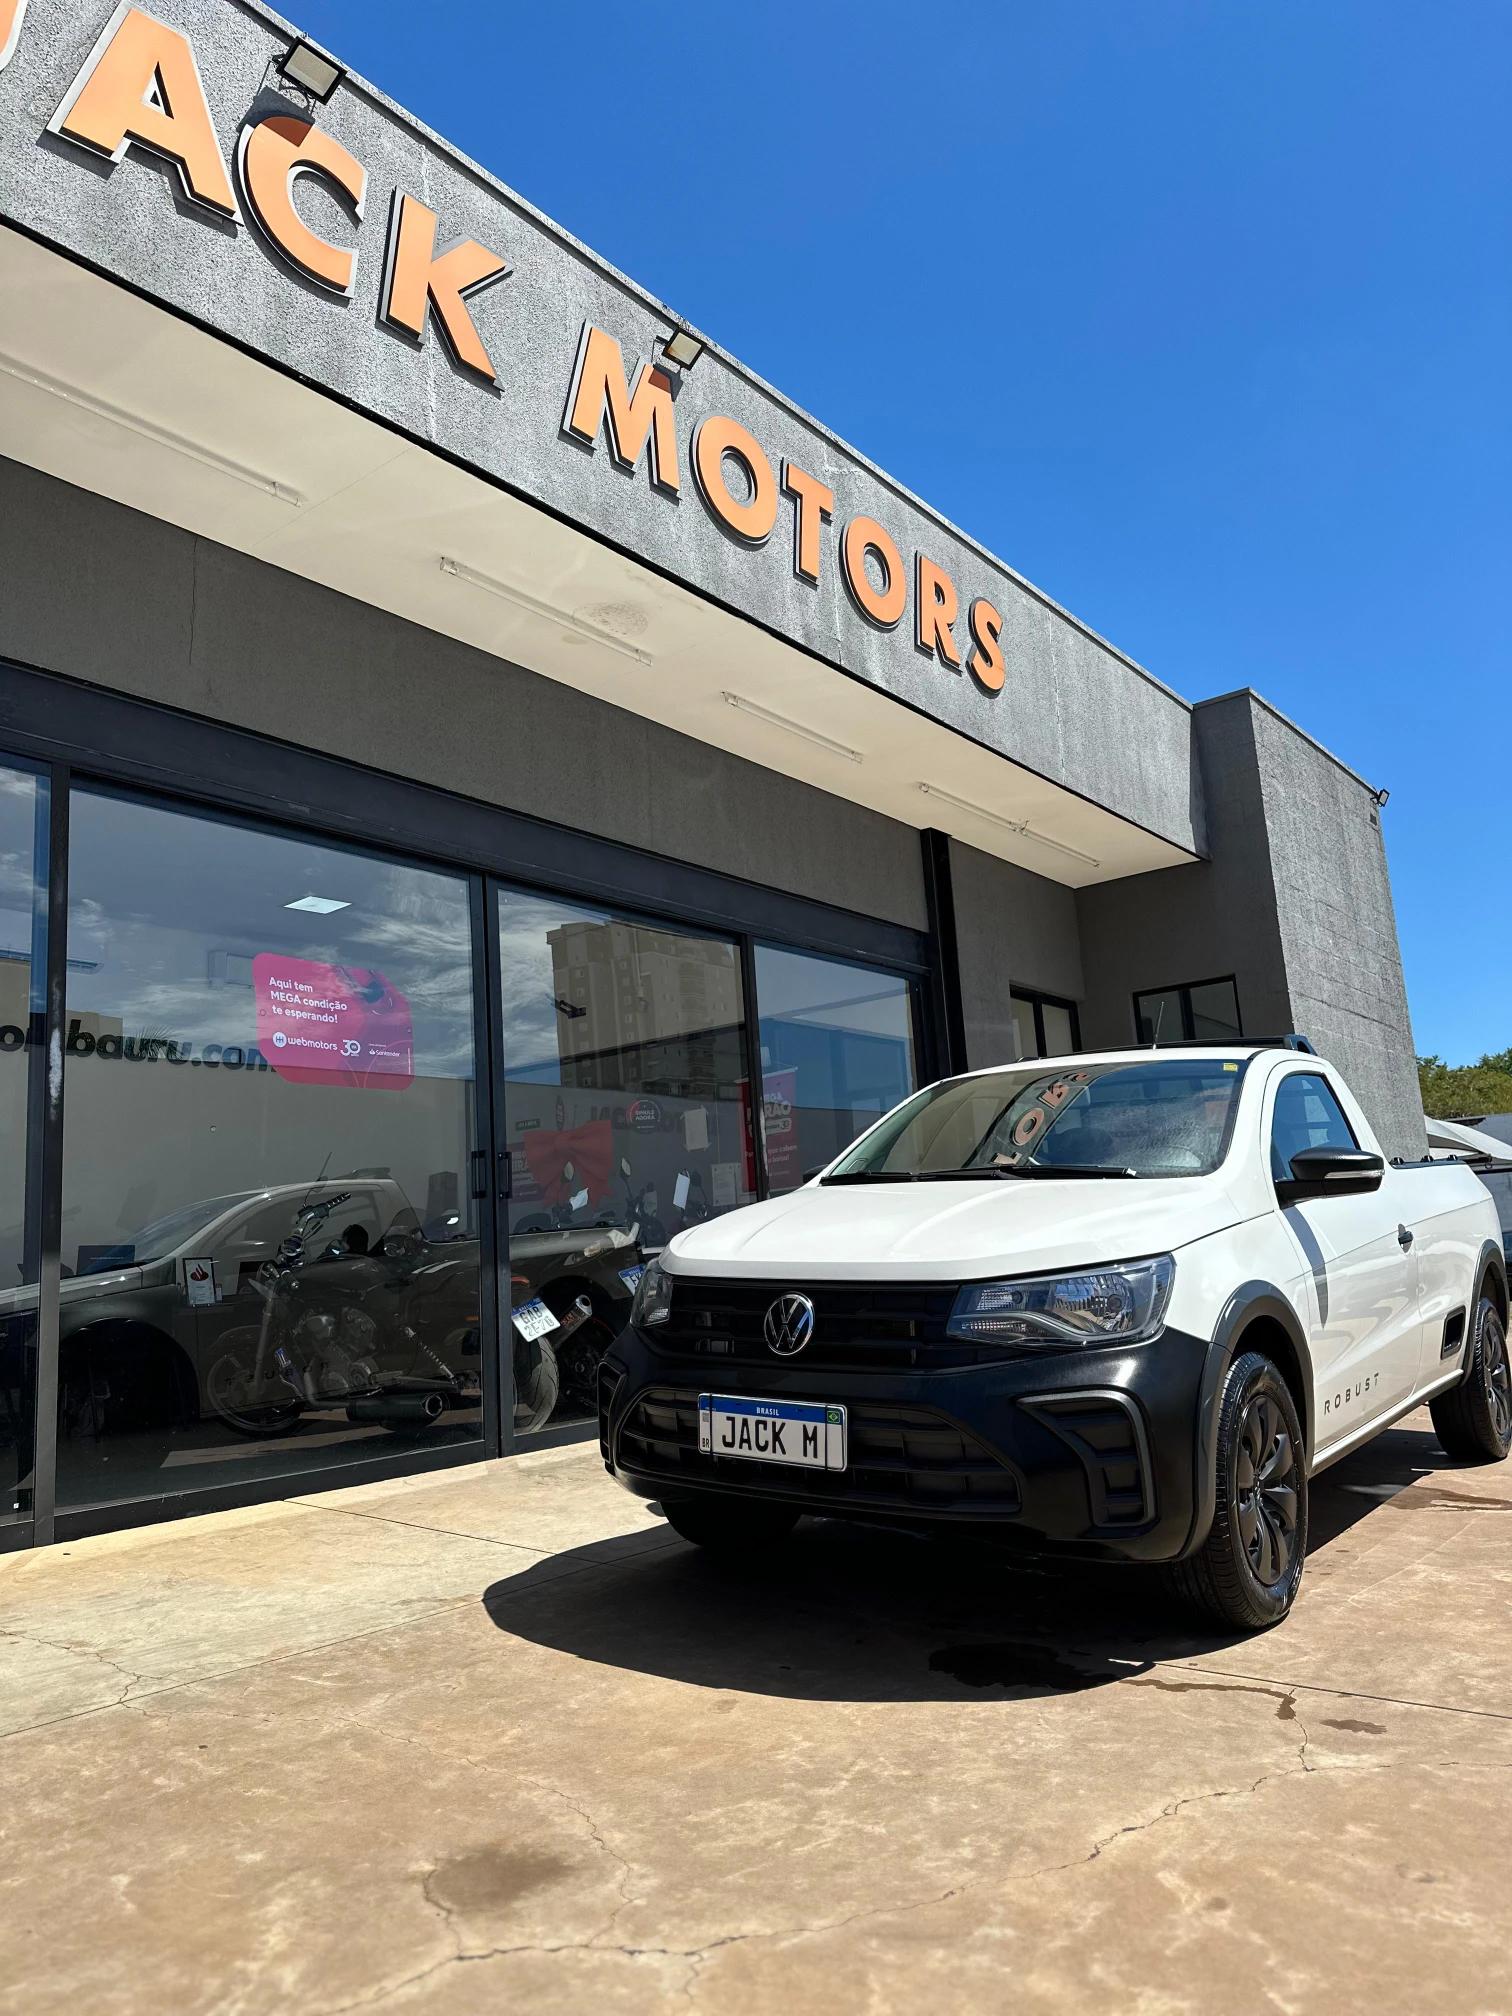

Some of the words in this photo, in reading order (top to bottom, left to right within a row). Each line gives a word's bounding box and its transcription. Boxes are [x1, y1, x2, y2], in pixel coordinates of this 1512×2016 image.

[0, 0, 512, 392] ACK
[561, 319, 1006, 695] MOTORS
[269, 976, 292, 990] Aqui
[294, 982, 313, 993] tem
[270, 991, 301, 1004] MEGA
[303, 997, 348, 1012] condição
[272, 1005, 283, 1015] te
[285, 1009, 338, 1024] esperando!
[288, 1036, 338, 1051] webmotors
[1323, 1372, 1380, 1416] ROBUST
[756, 1406, 780, 1416] BRASIL
[721, 1416, 787, 1455] JACK
[802, 1423, 818, 1459] M
